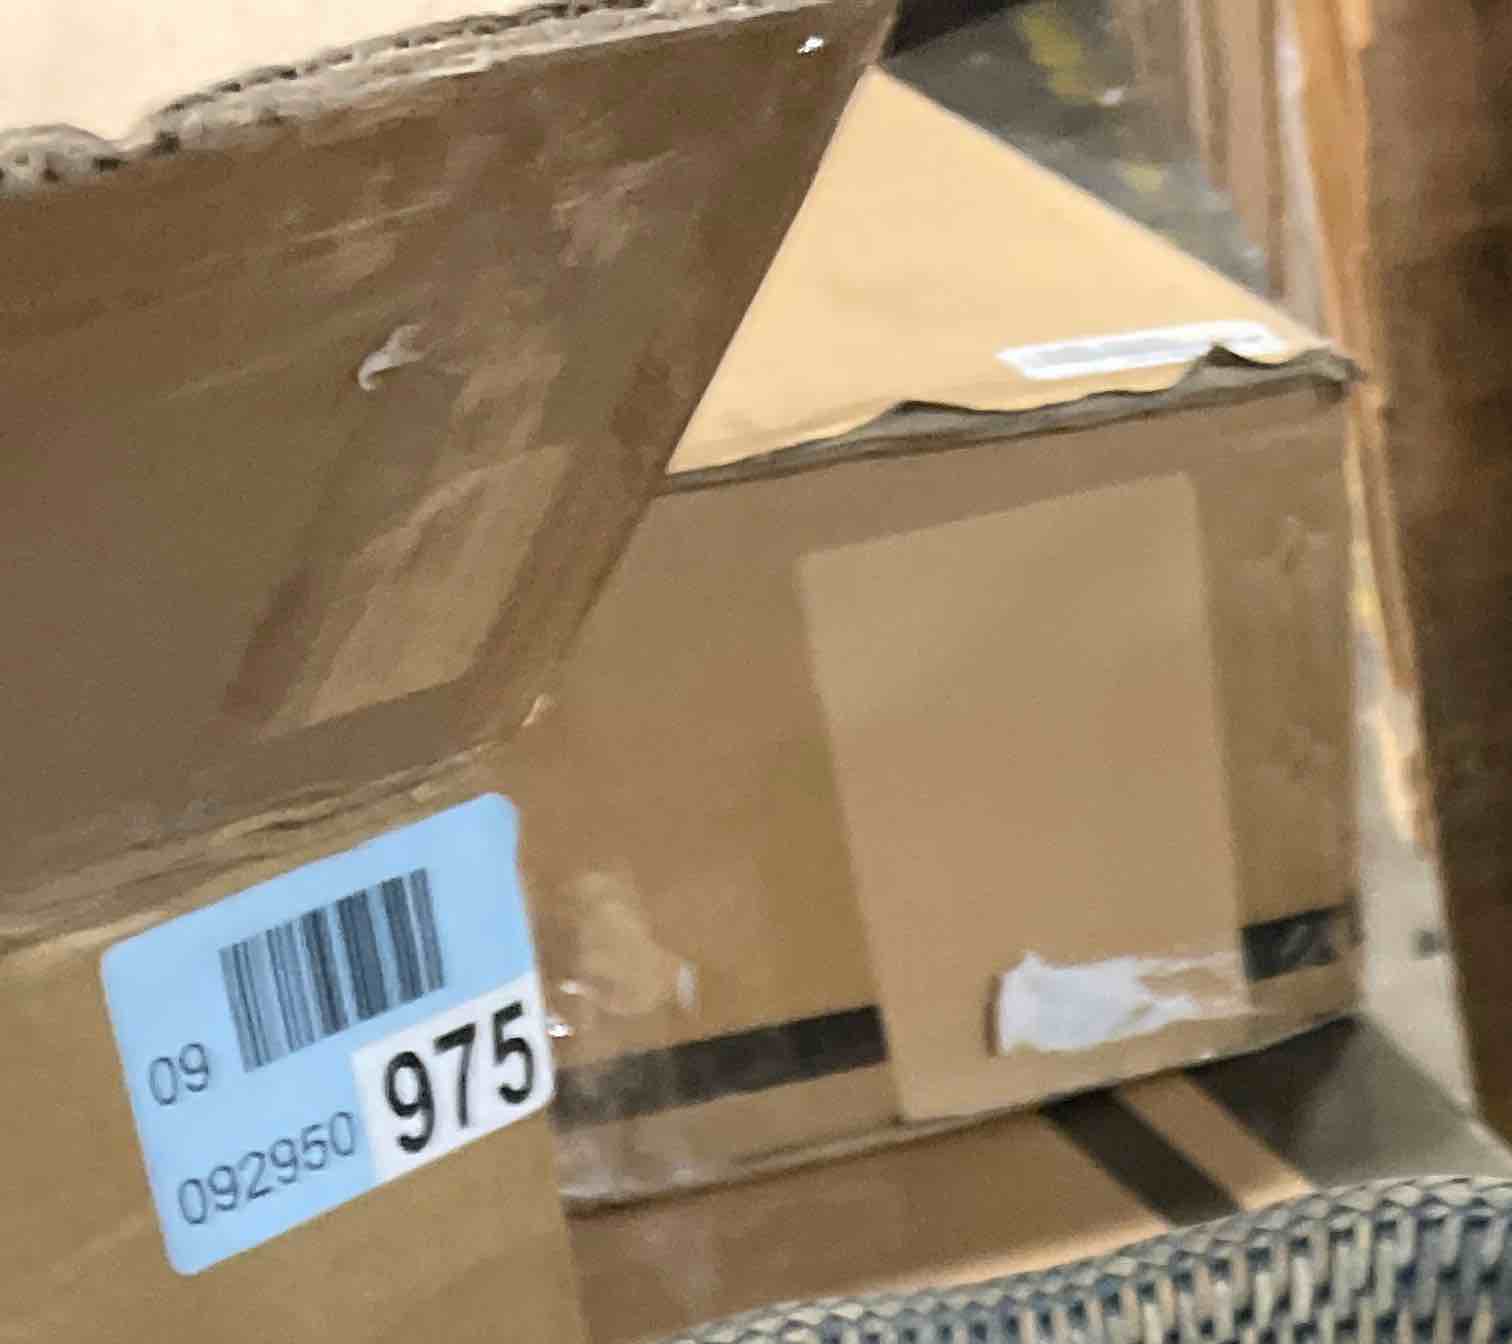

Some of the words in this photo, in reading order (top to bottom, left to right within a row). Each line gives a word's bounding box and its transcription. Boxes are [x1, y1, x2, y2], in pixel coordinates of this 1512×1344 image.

[149, 1042, 211, 1106] 09
[382, 1001, 536, 1156] 975
[177, 1110, 359, 1226] 092950
